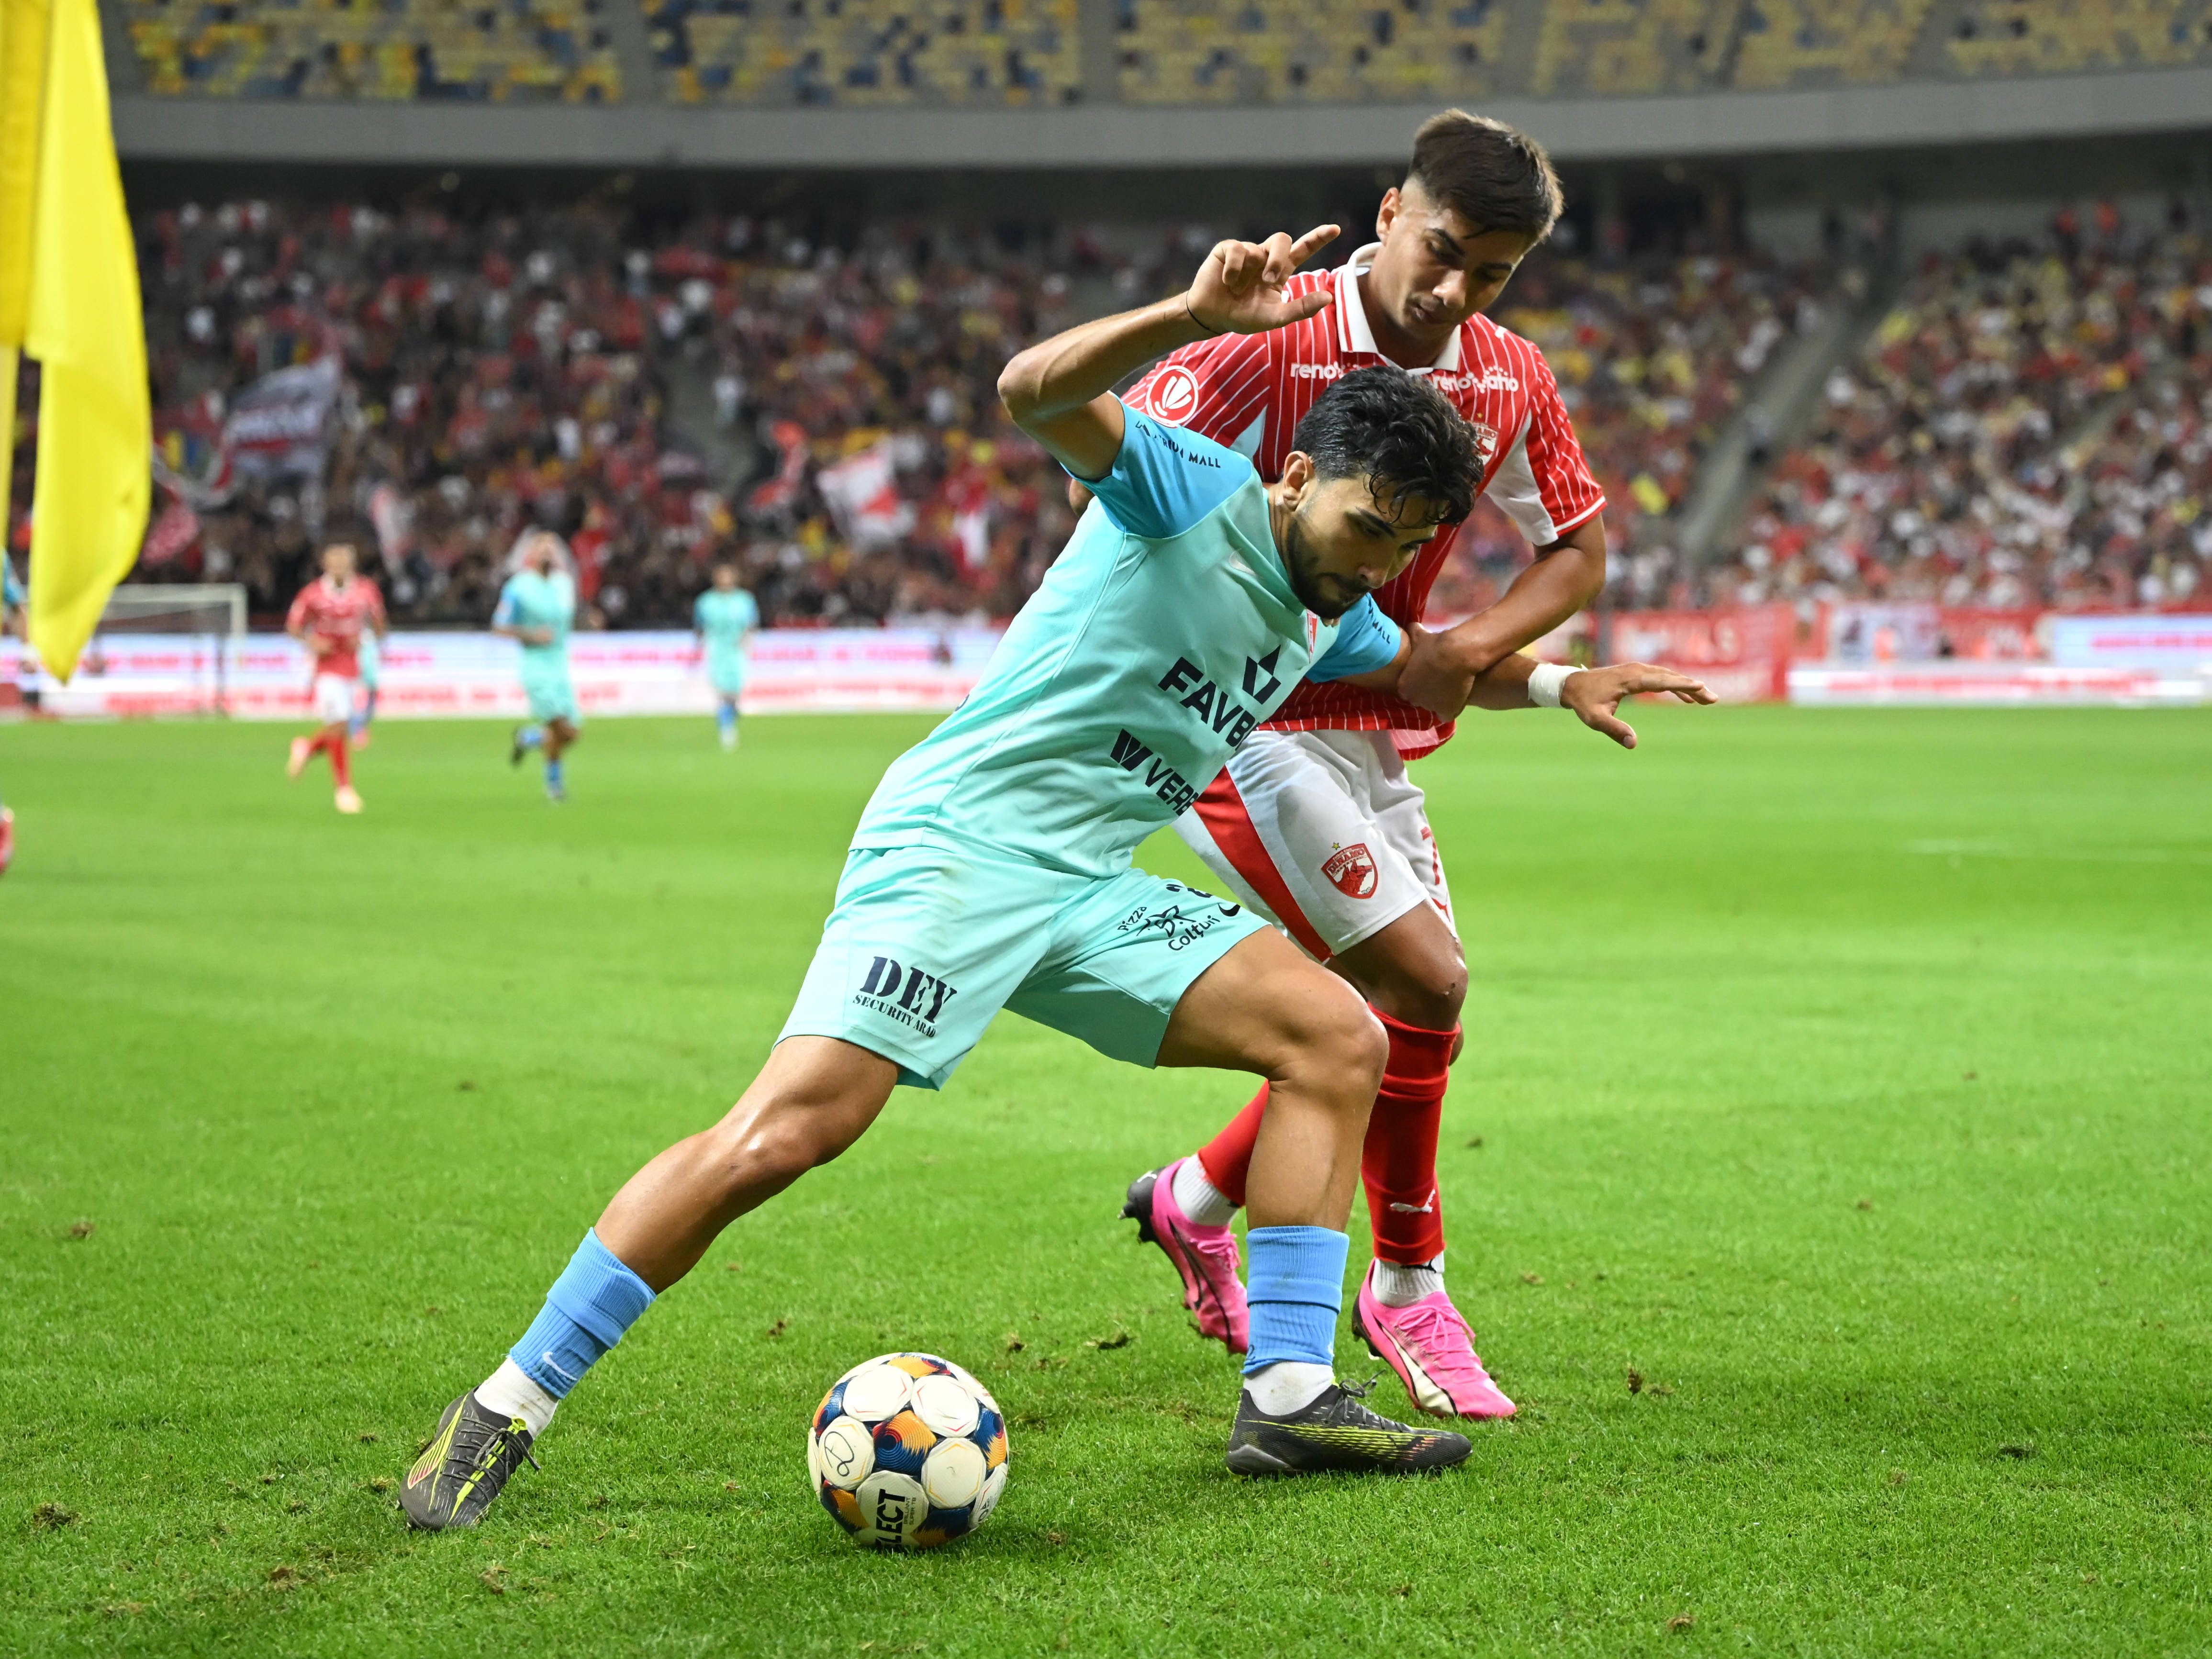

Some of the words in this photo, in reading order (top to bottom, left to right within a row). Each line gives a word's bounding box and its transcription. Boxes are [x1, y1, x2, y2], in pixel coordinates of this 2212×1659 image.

[1188, 451, 1221, 468] MALL
[1372, 619, 1390, 644] MALL
[1158, 657, 1261, 751] FAVB
[1145, 757, 1199, 816] VERB
[852, 994, 914, 1026] SECURITY
[913, 1019, 936, 1037] ARAD
[860, 956, 957, 1024] DEY
[875, 1488, 905, 1548] LECT
